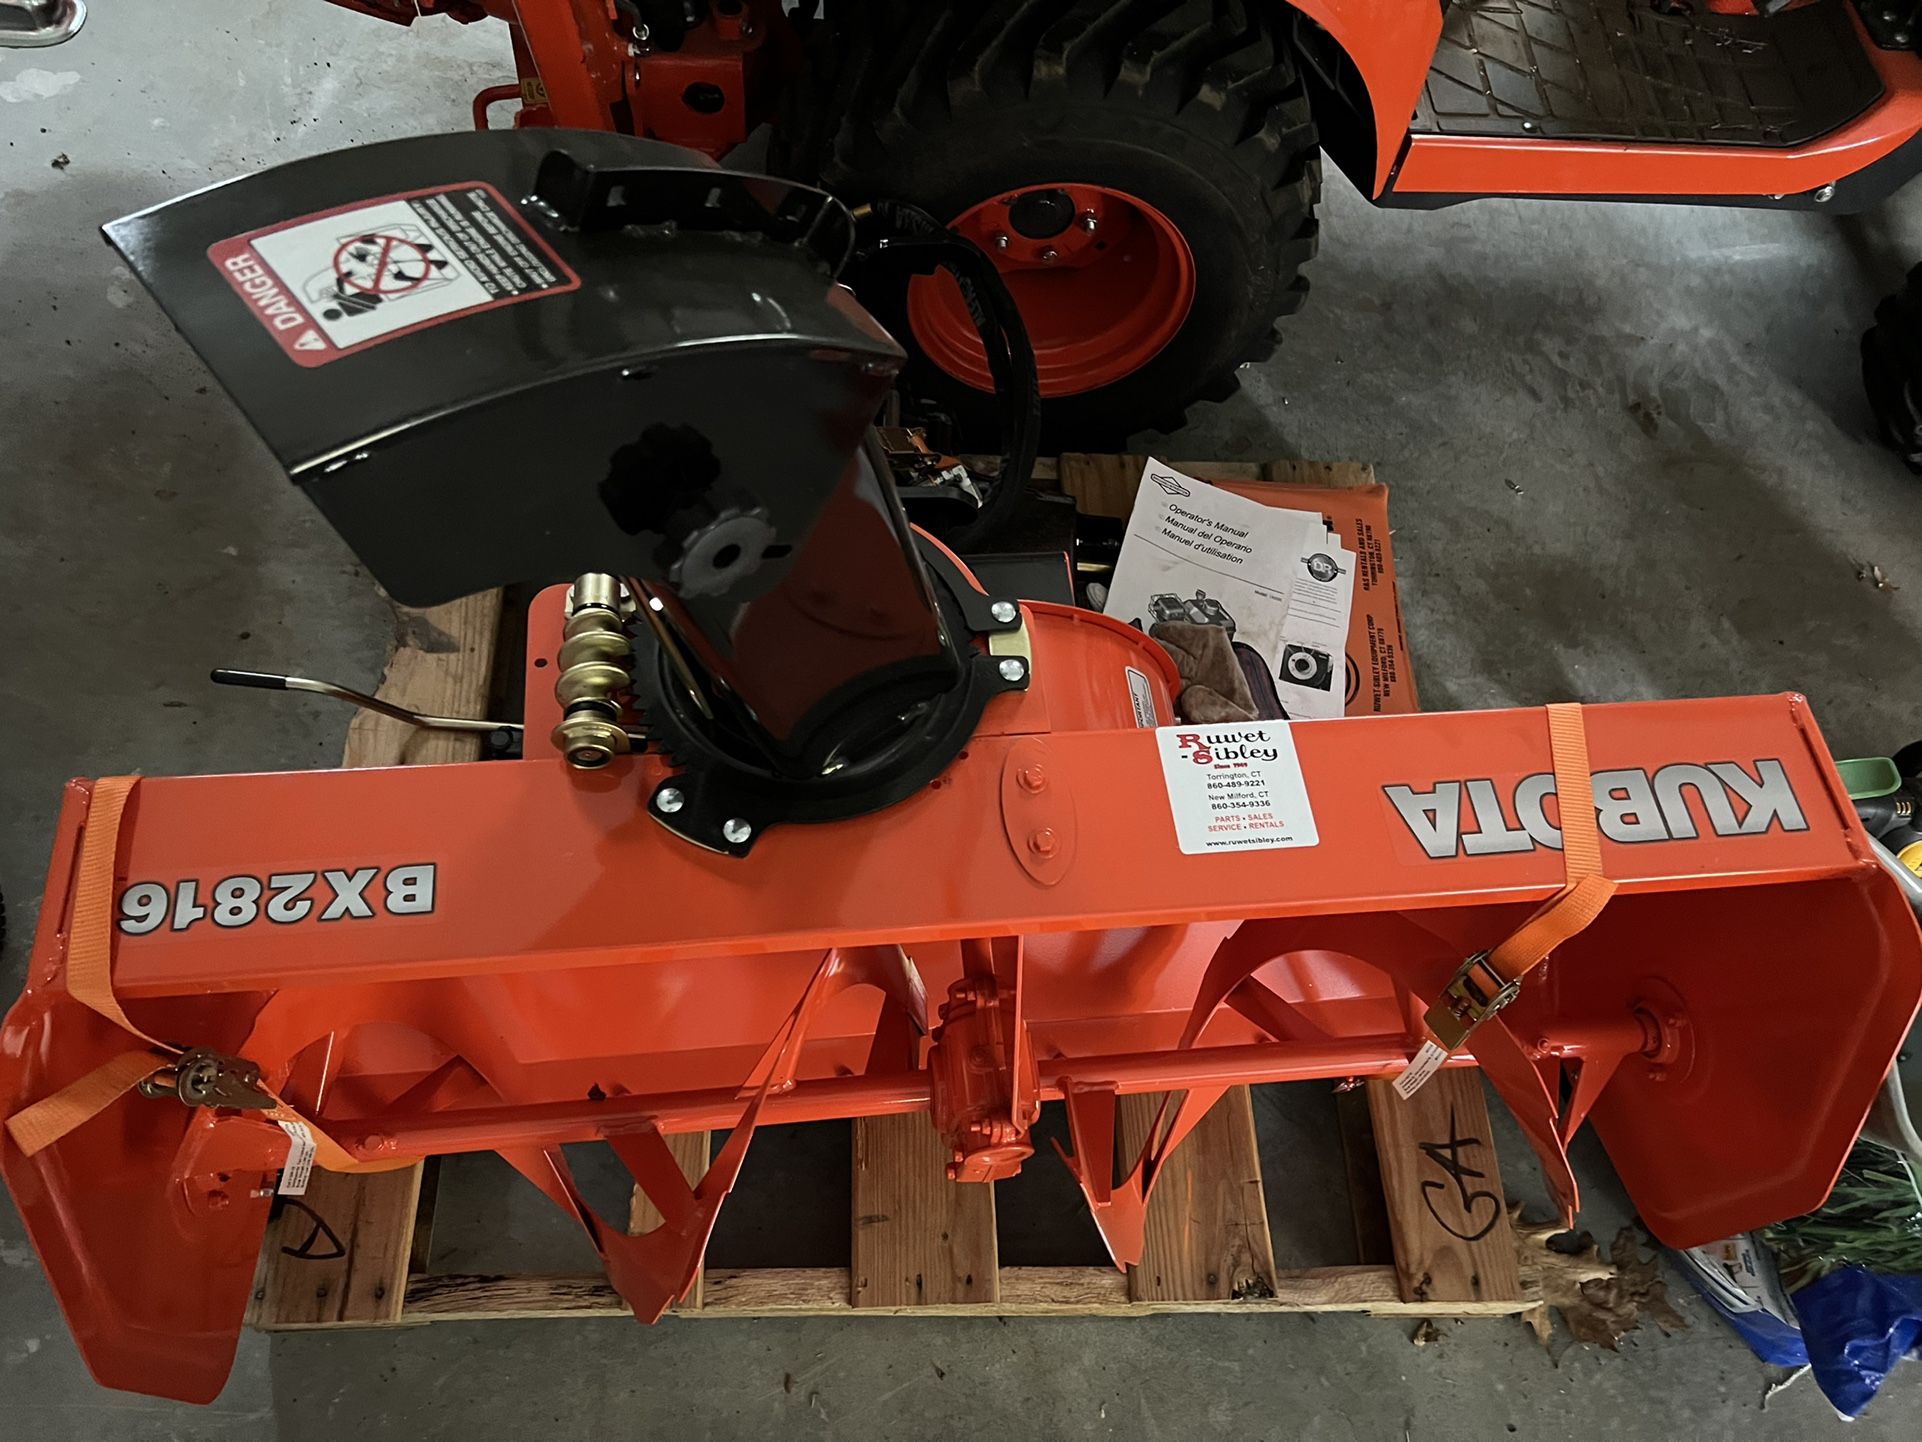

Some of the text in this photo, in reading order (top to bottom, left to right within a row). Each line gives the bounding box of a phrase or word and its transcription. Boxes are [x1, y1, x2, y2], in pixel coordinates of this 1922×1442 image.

[224, 252, 305, 331] DANGER
[1165, 516, 1198, 534] Manual
[1197, 531, 1213, 540] del
[1169, 503, 1249, 538] Operator's Manual
[1355, 518, 1363, 536] SALES
[1162, 528, 1244, 564] Manuel d'utilisation
[1312, 558, 1333, 576] DR
[1368, 630, 1378, 665] EQUIPMENT
[1176, 730, 1271, 750] Ruwet
[1207, 780, 1266, 789] 860-489-9221
[1211, 800, 1271, 810] 860-354-9336
[1382, 758, 1810, 859] KUBOTA
[1208, 821, 1284, 832] SERVICE RENTALS
[1215, 813, 1273, 822] PARTS SALES
[1206, 836, 1293, 847] www.ruwetsibley.com
[117, 862, 437, 936] BX2816
